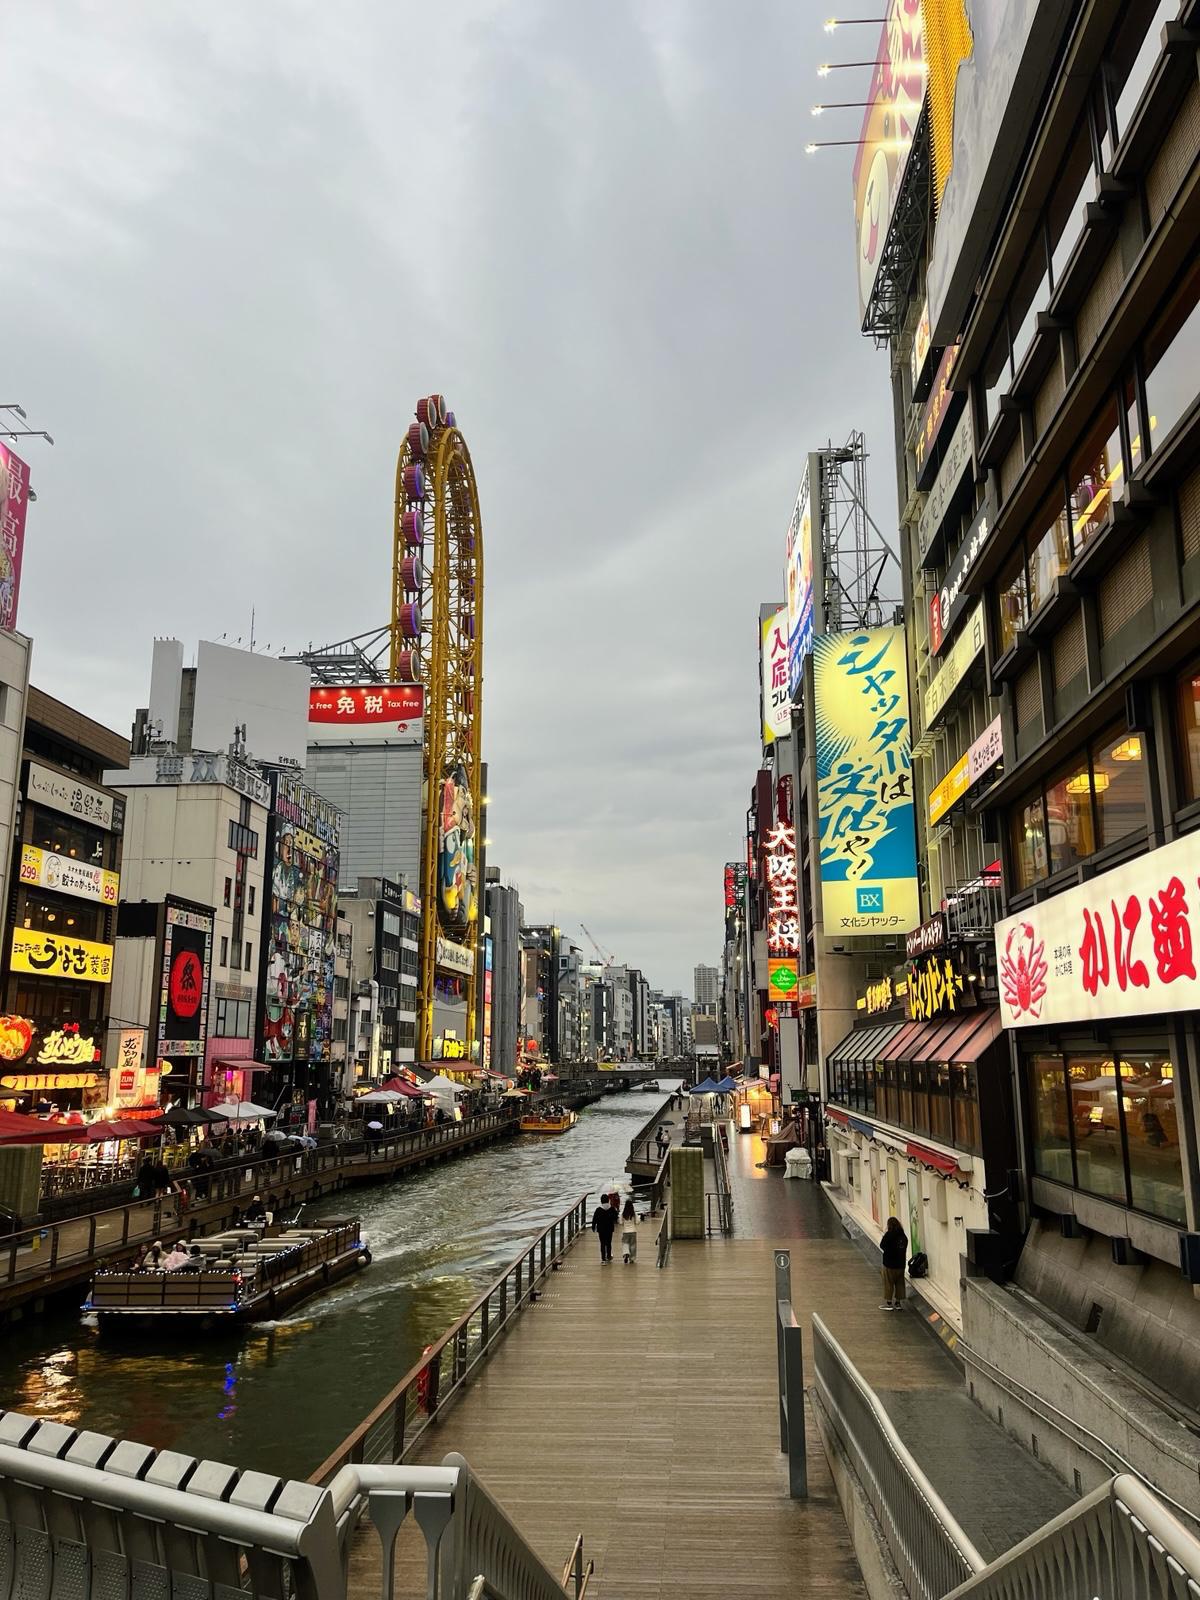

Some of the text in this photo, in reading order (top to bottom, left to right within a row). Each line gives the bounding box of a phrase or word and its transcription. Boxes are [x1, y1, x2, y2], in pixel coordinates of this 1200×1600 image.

[336, 695, 384, 714] 免税
[387, 699, 419, 708] Tax Free
[766, 822, 799, 951] 大阪王将
[860, 893, 881, 908] BX
[1079, 875, 1200, 998] かに道
[28, 937, 89, 975] うなぎ
